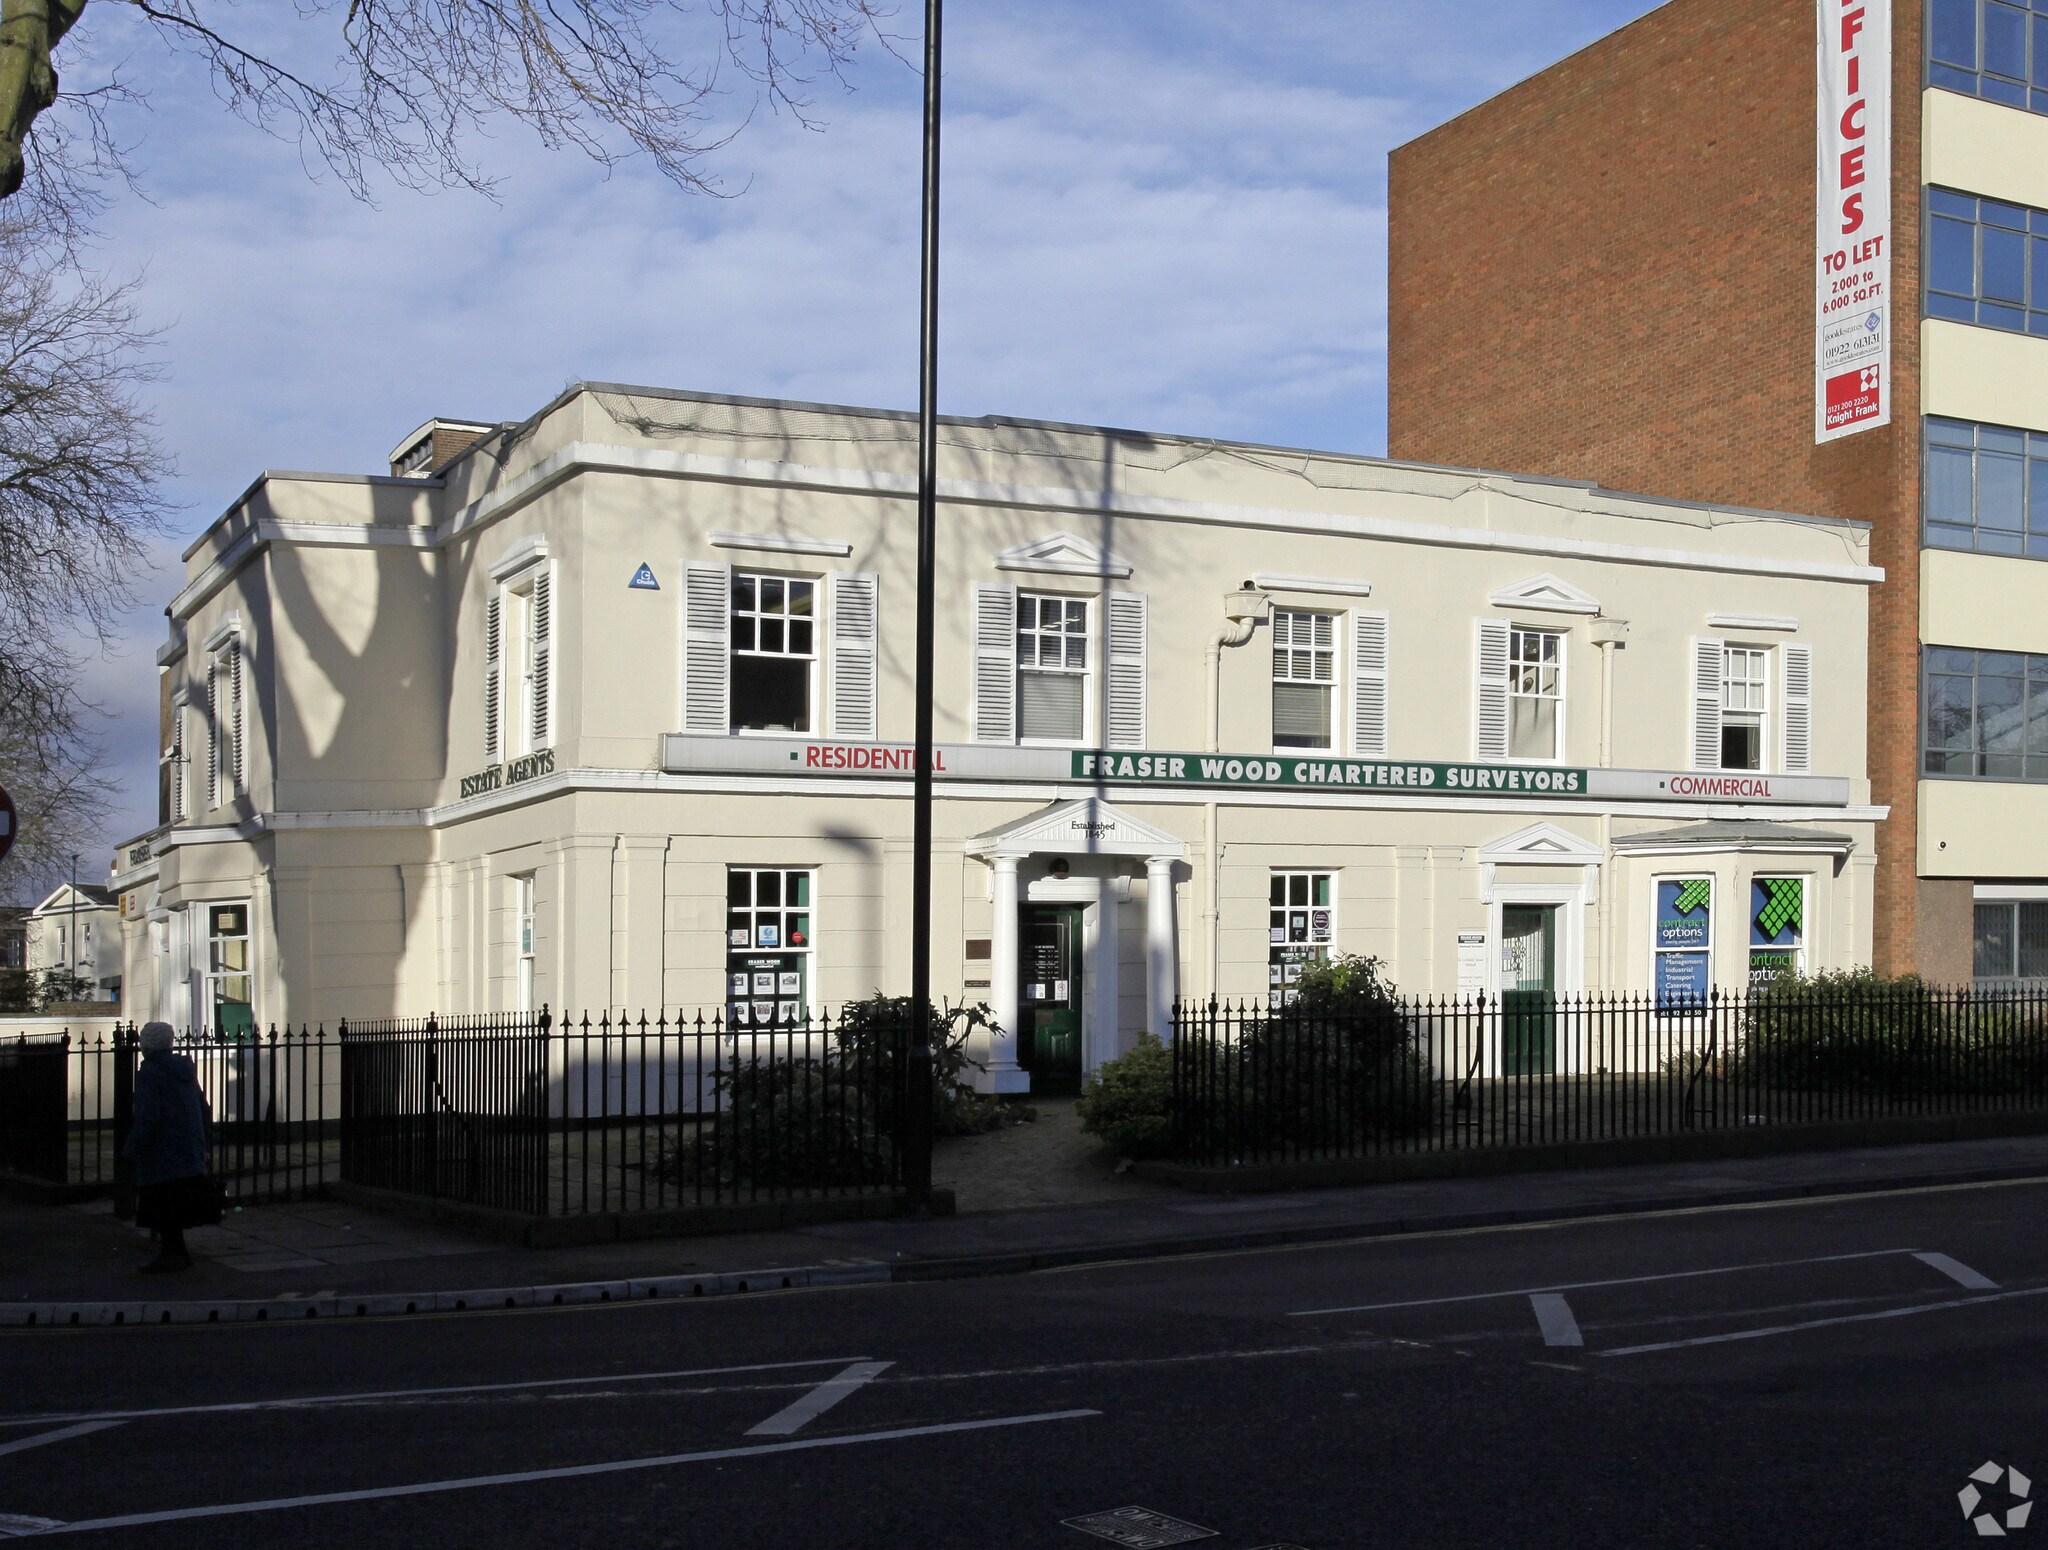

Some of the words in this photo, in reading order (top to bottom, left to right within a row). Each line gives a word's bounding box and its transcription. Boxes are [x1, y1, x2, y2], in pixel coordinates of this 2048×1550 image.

[1840, 0, 1866, 235] FICES
[1823, 250, 1847, 275] TO
[1852, 235, 1884, 265] LET
[1832, 275, 1859, 293] 2,000
[1863, 270, 1874, 284] to
[1822, 296, 1850, 315] 6,000
[1825, 343, 1850, 360] 01922
[1853, 332, 1880, 350] 613131
[1827, 410, 1853, 426] Knight
[1856, 402, 1878, 418] Frank
[1828, 404, 1840, 414] 0121
[1841, 400, 1853, 410] 200
[1854, 395, 1869, 407] 2220
[806, 746, 946, 771] RESIDENTIL
[460, 767, 503, 799] ESTATE
[505, 750, 555, 786] AGENTS
[1082, 755, 1186, 778] FRASER
[1200, 758, 1282, 781] WOOD
[1294, 762, 1435, 786] CHARTERED
[1446, 767, 1579, 791] SURVEYORS
[1670, 776, 1771, 797] COMMERCIAL
[1071, 821, 1115, 832] Established
[1085, 830, 1106, 840] 1845
[1659, 917, 1706, 928] contract
[1662, 927, 1703, 939] options
